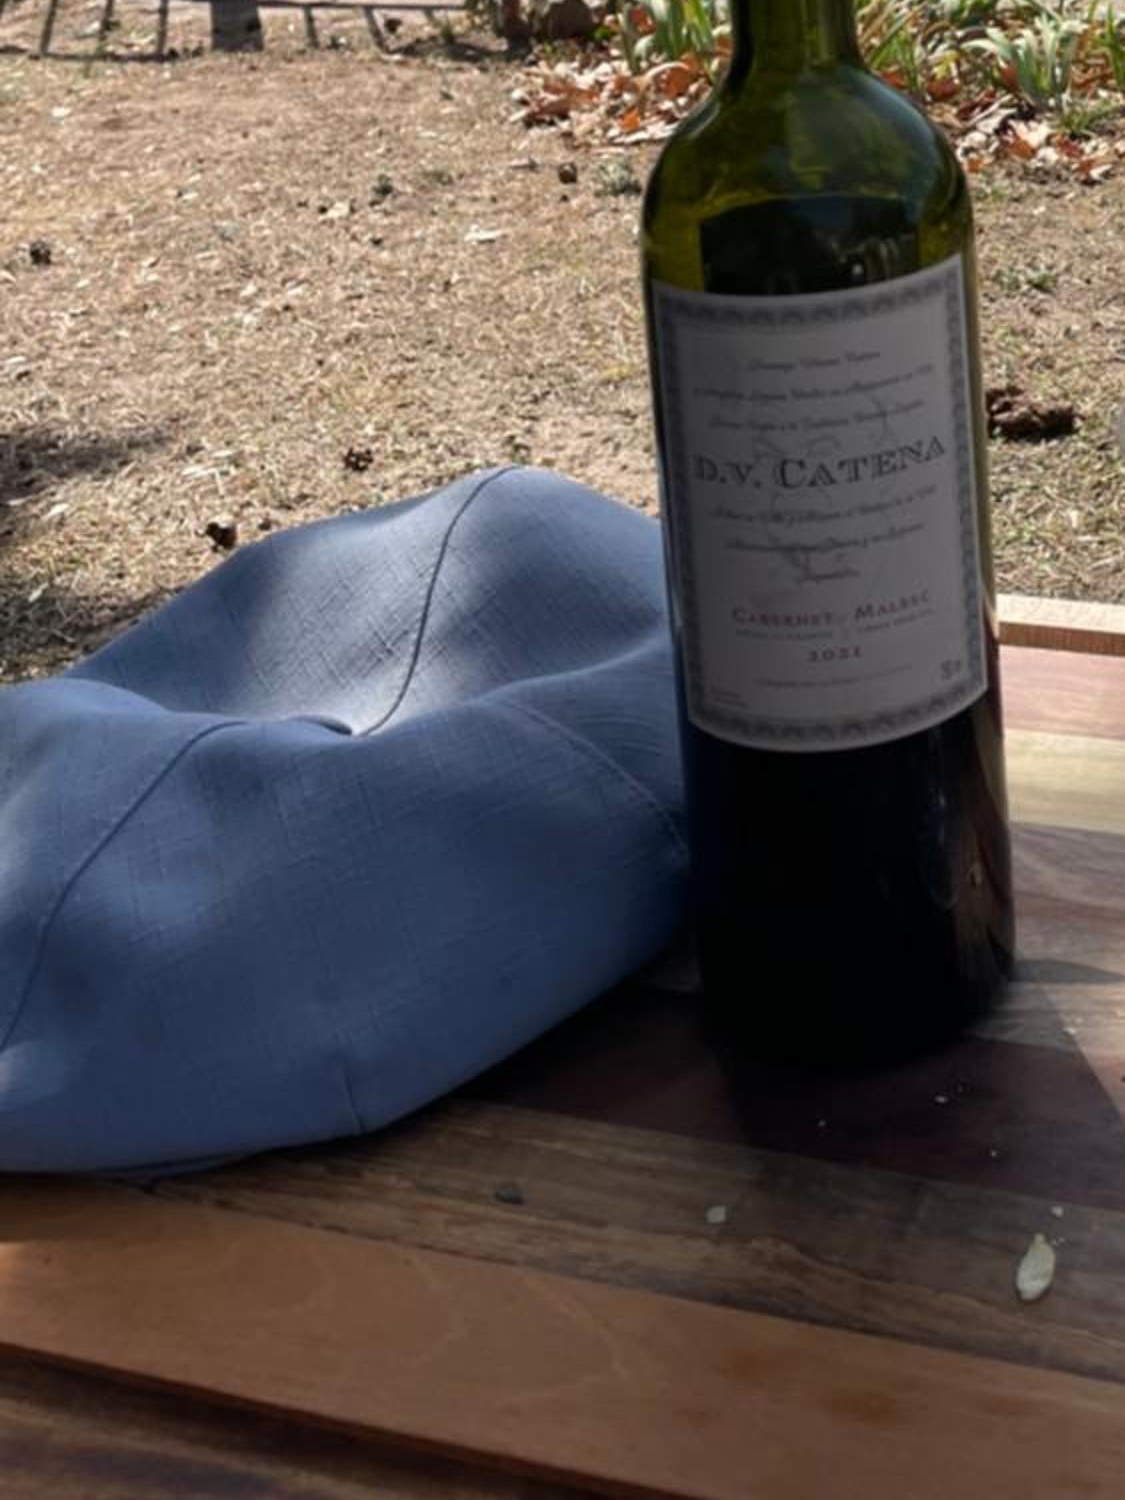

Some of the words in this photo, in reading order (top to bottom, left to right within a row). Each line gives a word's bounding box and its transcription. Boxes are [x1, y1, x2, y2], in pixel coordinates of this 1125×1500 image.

[776, 435, 946, 490] CATENA
[732, 606, 833, 629] CABERNET
[854, 589, 930, 621] MALBEC
